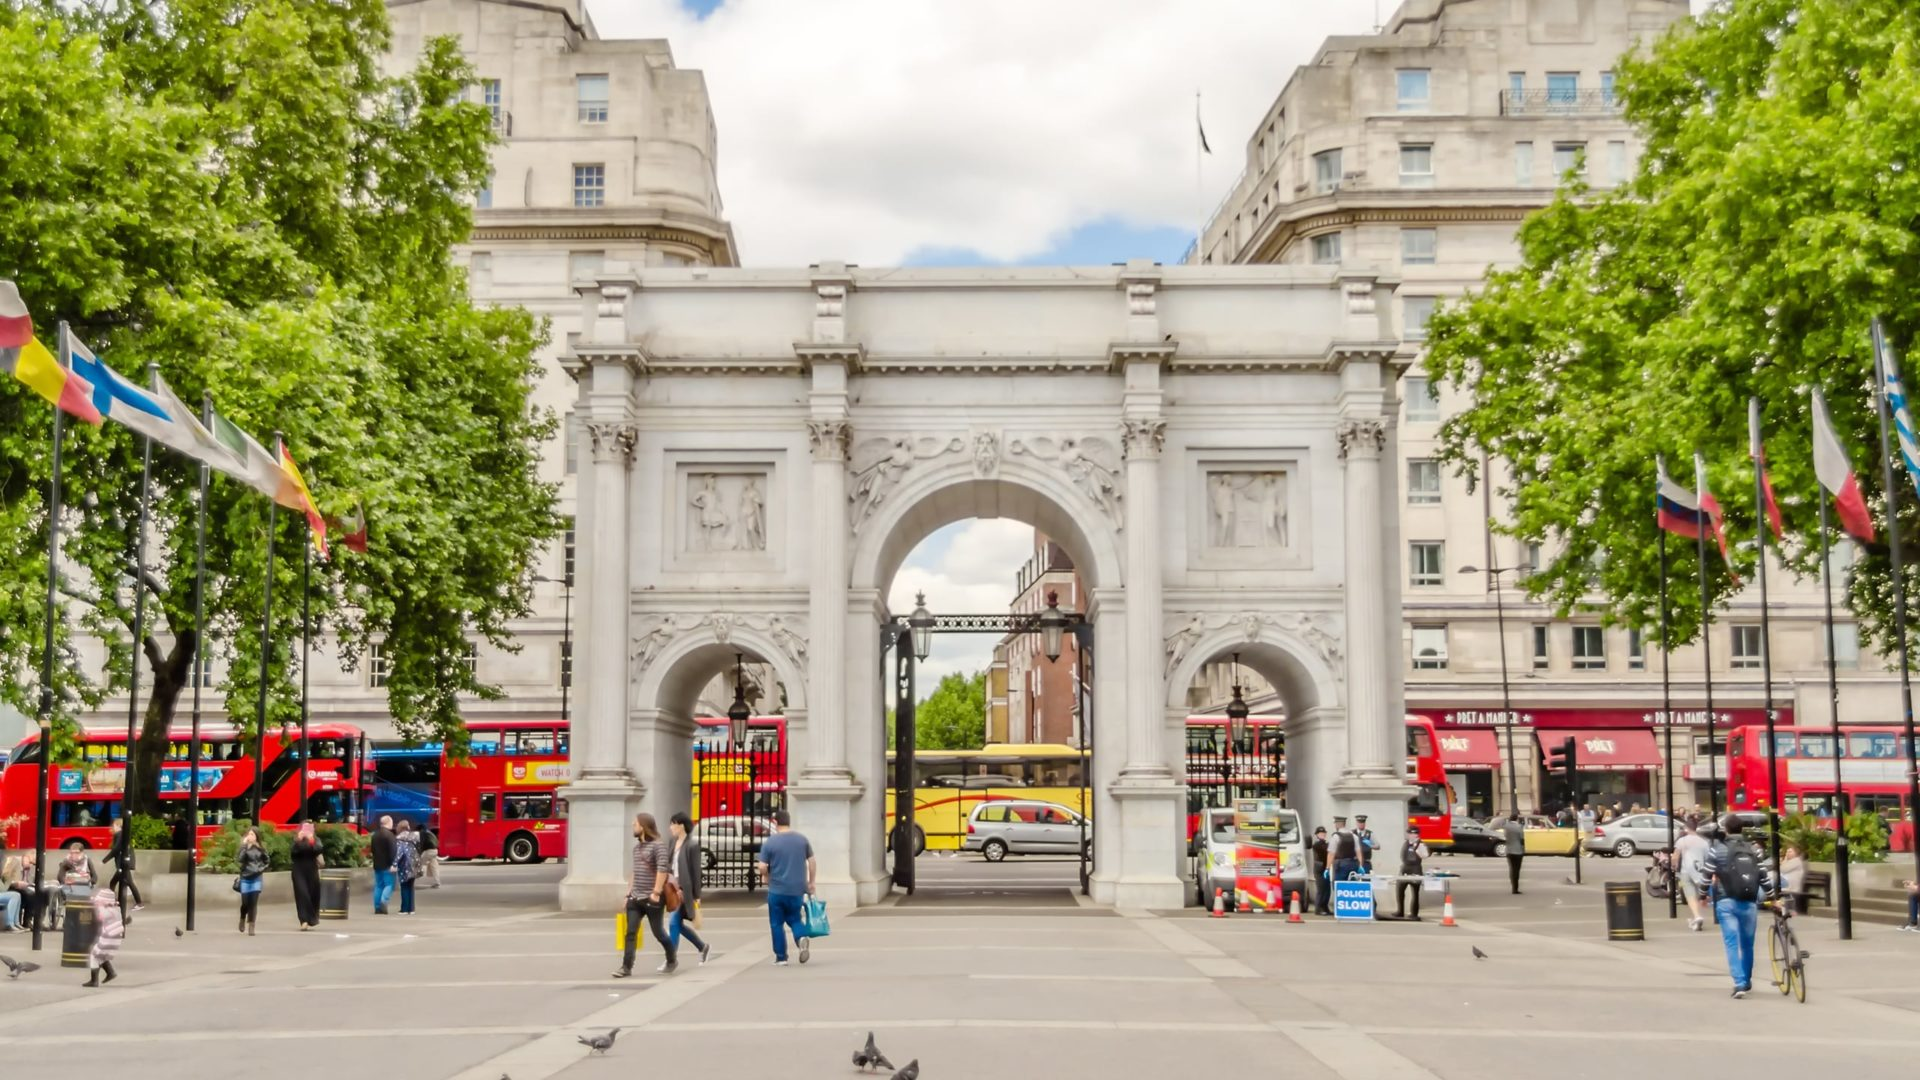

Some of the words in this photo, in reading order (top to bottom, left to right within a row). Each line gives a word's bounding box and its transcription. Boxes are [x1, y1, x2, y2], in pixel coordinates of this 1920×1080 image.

[1456, 711, 1477, 724] PRET
[1478, 711, 1484, 724] A
[1654, 711, 1675, 724] PRT
[1676, 711, 1682, 724] A
[1337, 889, 1370, 898] POLICE
[1337, 900, 1370, 910] SLOW
